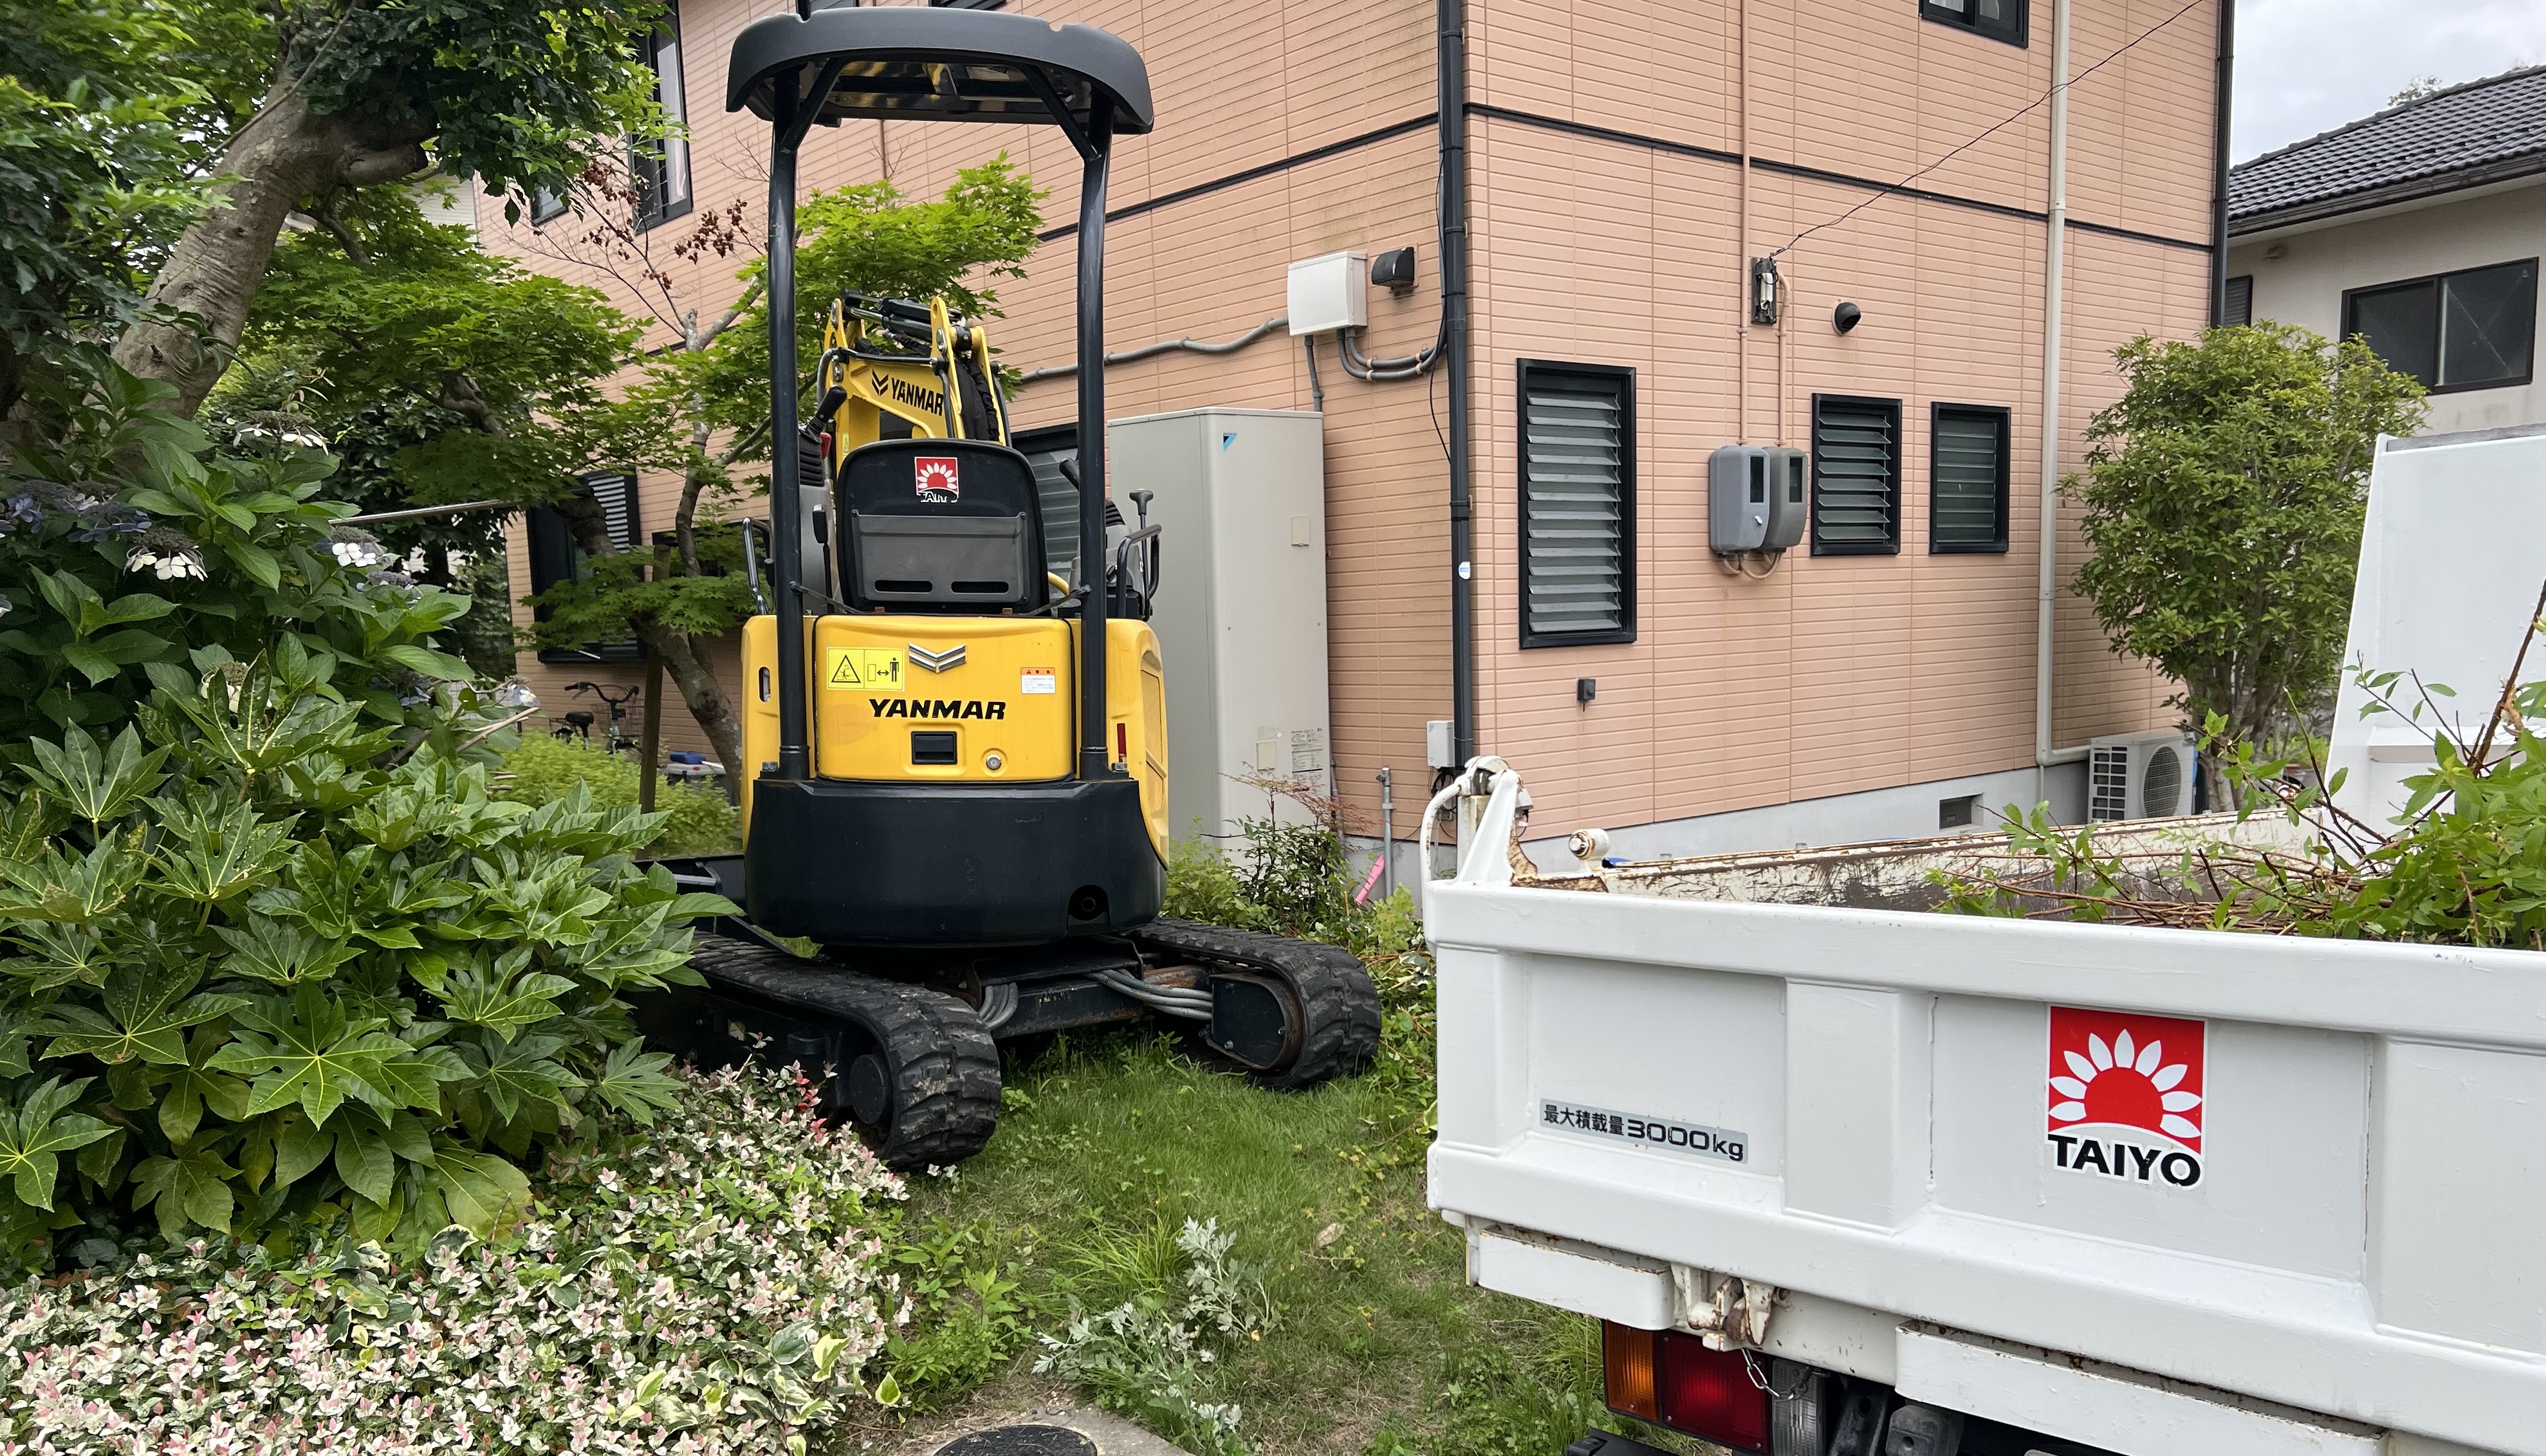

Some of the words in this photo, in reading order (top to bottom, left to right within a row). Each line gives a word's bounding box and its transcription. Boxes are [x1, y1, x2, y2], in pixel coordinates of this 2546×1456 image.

[891, 377, 944, 416] YANMAR
[869, 698, 1006, 720] YANMAR
[2047, 1133, 2201, 1187] TAIYO
